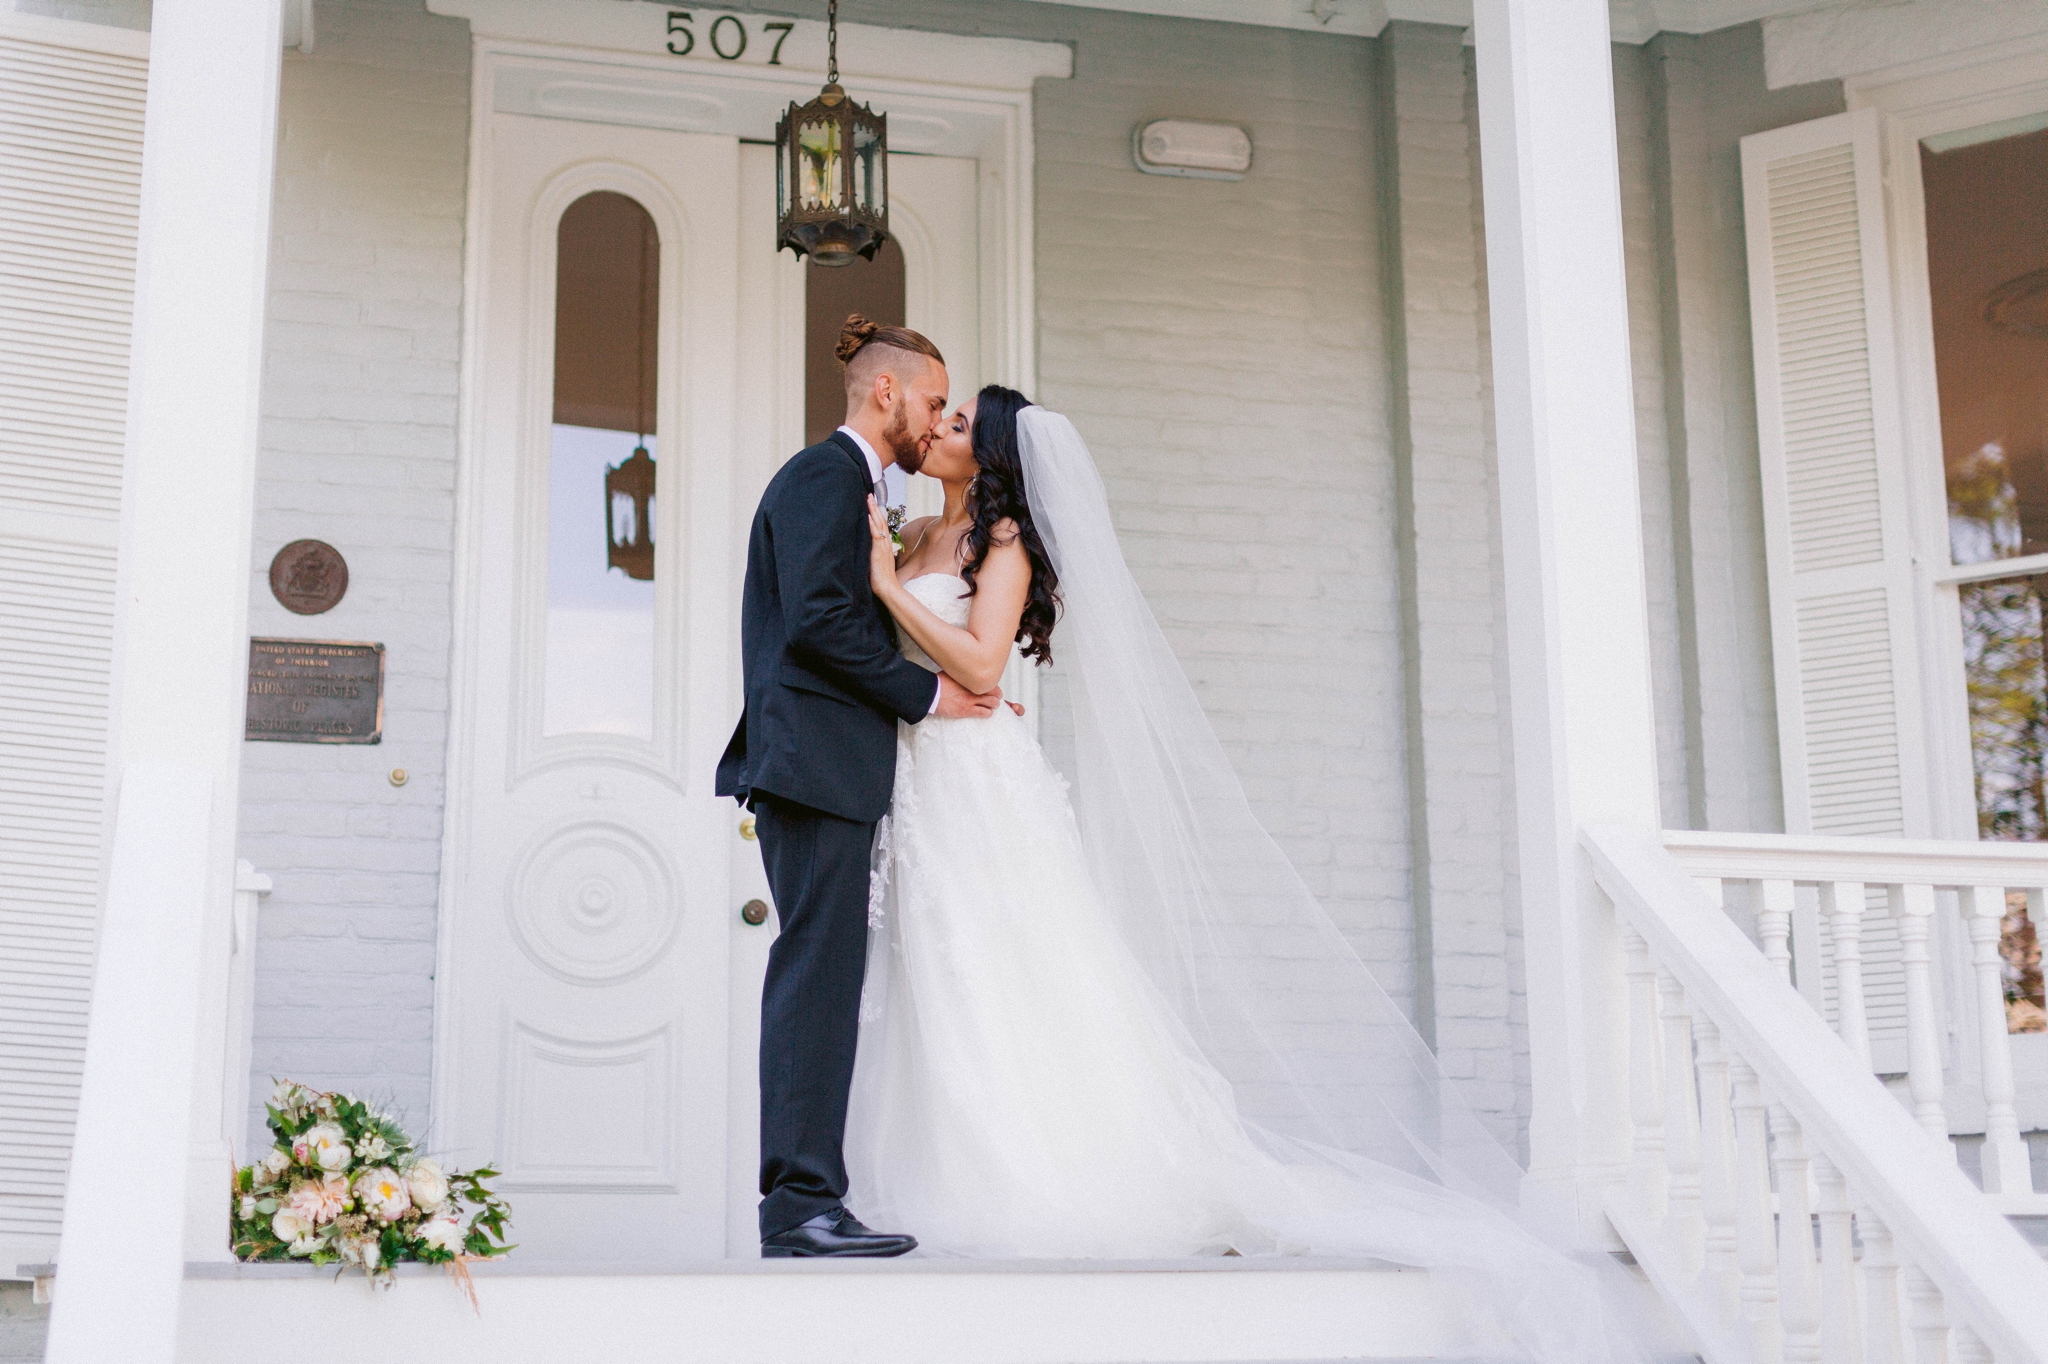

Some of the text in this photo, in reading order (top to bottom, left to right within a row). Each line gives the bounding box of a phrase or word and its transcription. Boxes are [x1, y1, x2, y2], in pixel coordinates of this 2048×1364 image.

[666, 11, 795, 65] 507
[256, 646, 368, 658] UNITED STATES DEPARTMENT
[291, 658, 329, 667] INTERIOR
[250, 681, 360, 699] ATIONAL REGISTER
[292, 701, 309, 713] OF
[310, 720, 353, 734] PLACES
